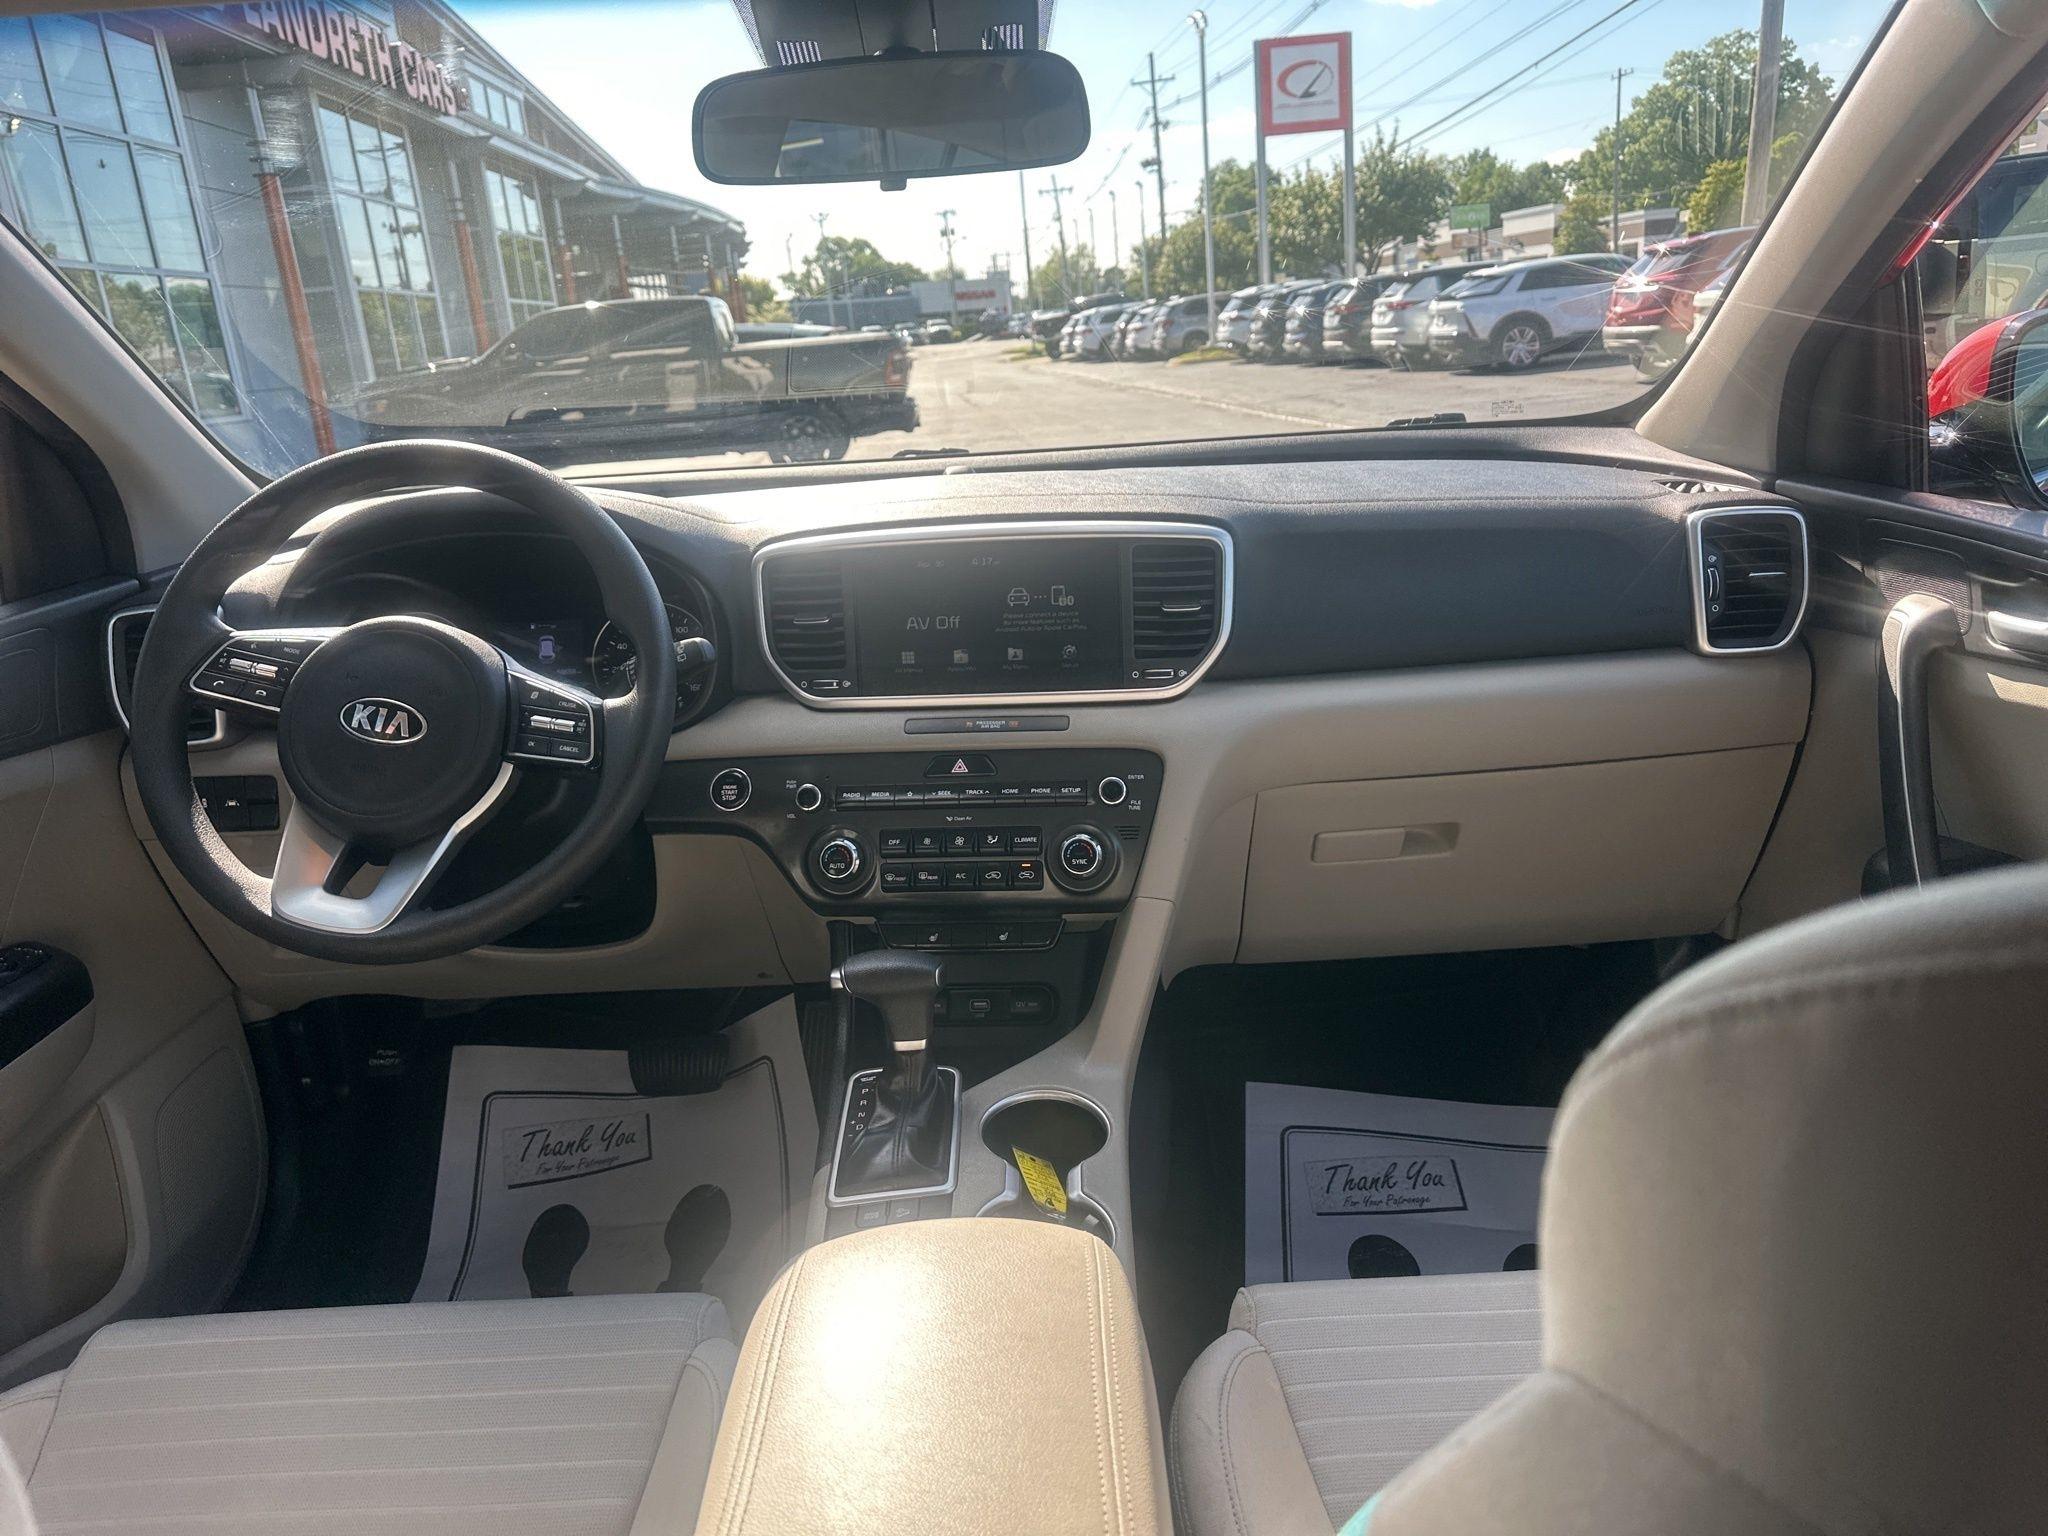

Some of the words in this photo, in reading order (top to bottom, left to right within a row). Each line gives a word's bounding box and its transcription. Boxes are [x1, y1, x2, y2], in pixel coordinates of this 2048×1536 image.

[400, 40, 458, 116] CARS
[906, 616, 930, 630] AV
[936, 615, 961, 629] Off
[351, 703, 409, 738] KIA
[559, 744, 580, 753] CANCEL
[520, 1124, 595, 1163] Thank
[601, 1120, 637, 1152] You
[855, 1123, 864, 1131] D
[1324, 1161, 1399, 1194] Thank
[1406, 1159, 1446, 1190] You
